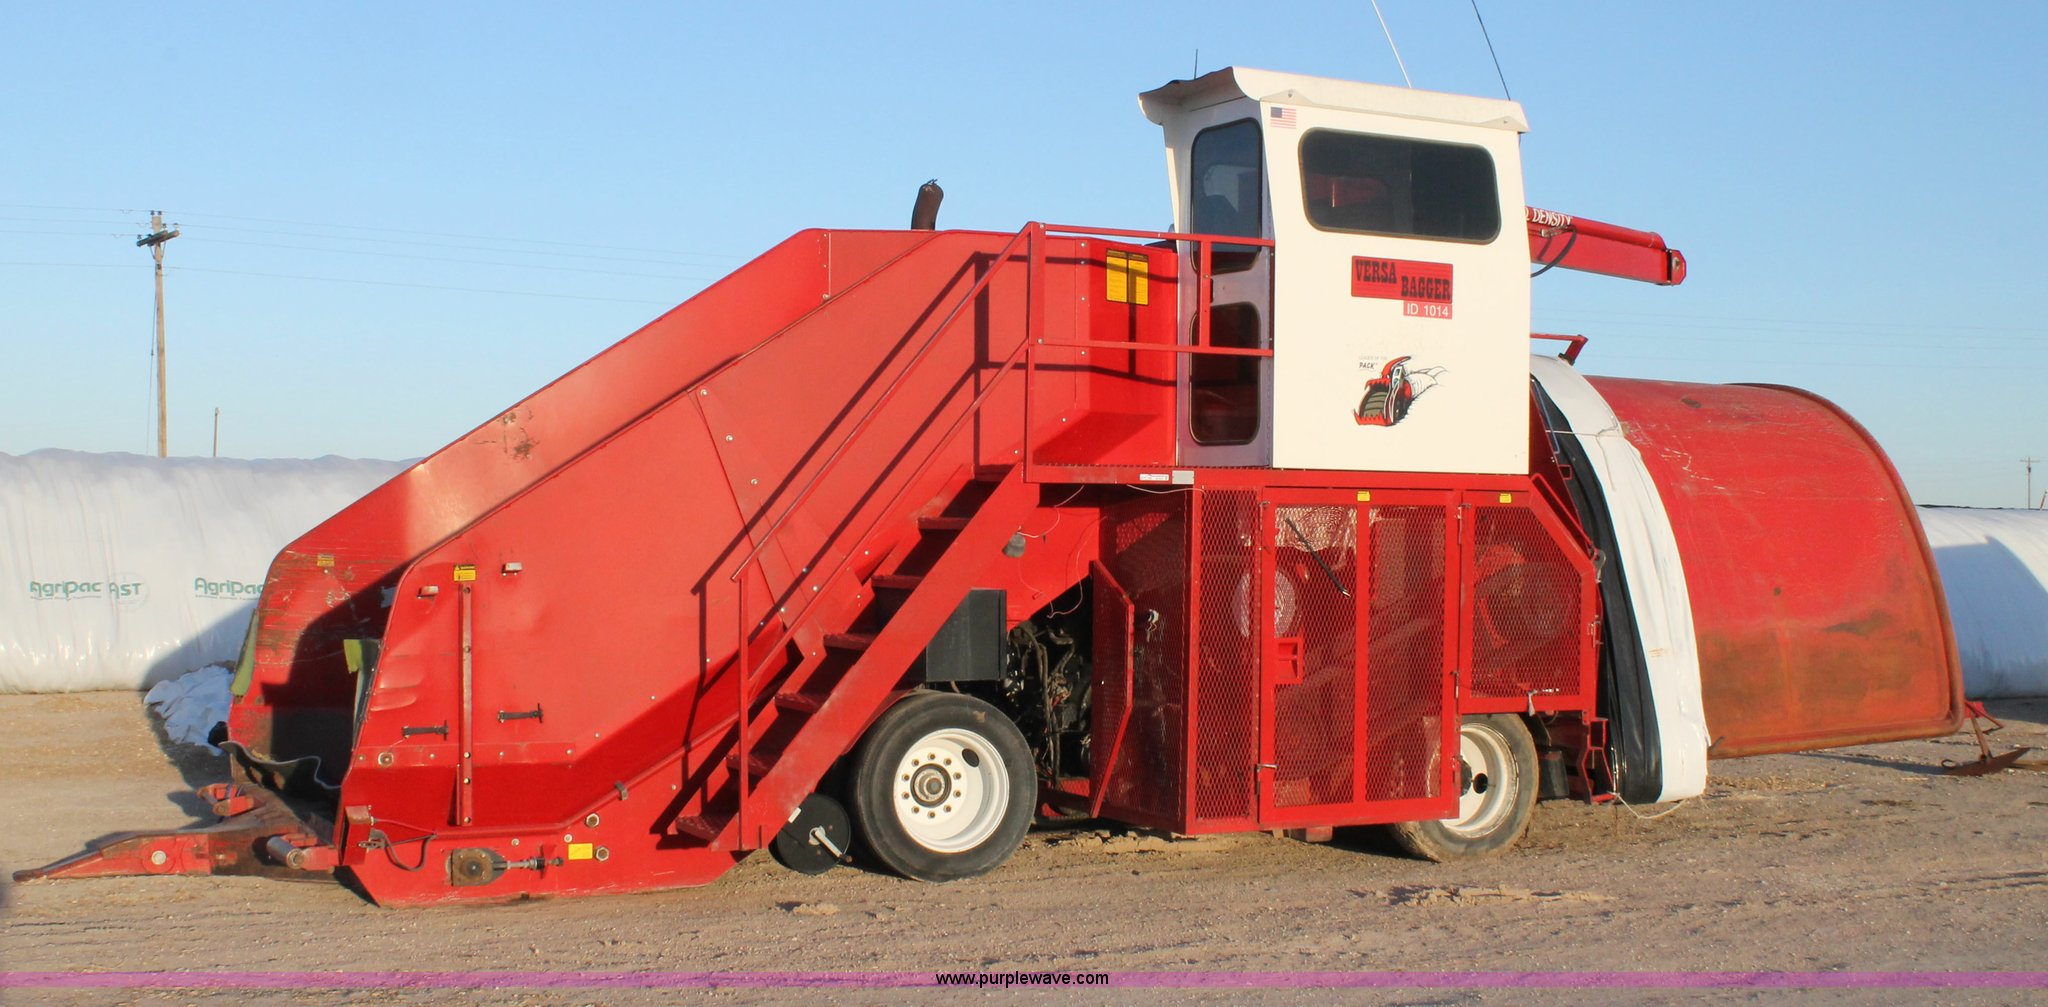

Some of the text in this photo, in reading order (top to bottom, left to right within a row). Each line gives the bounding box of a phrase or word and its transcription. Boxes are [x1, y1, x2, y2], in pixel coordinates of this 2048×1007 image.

[1532, 208, 1571, 226] DENSITY
[1355, 259, 1397, 284] VERSA
[1401, 275, 1451, 300] BAGGER
[1407, 303, 1449, 318] ID 1014
